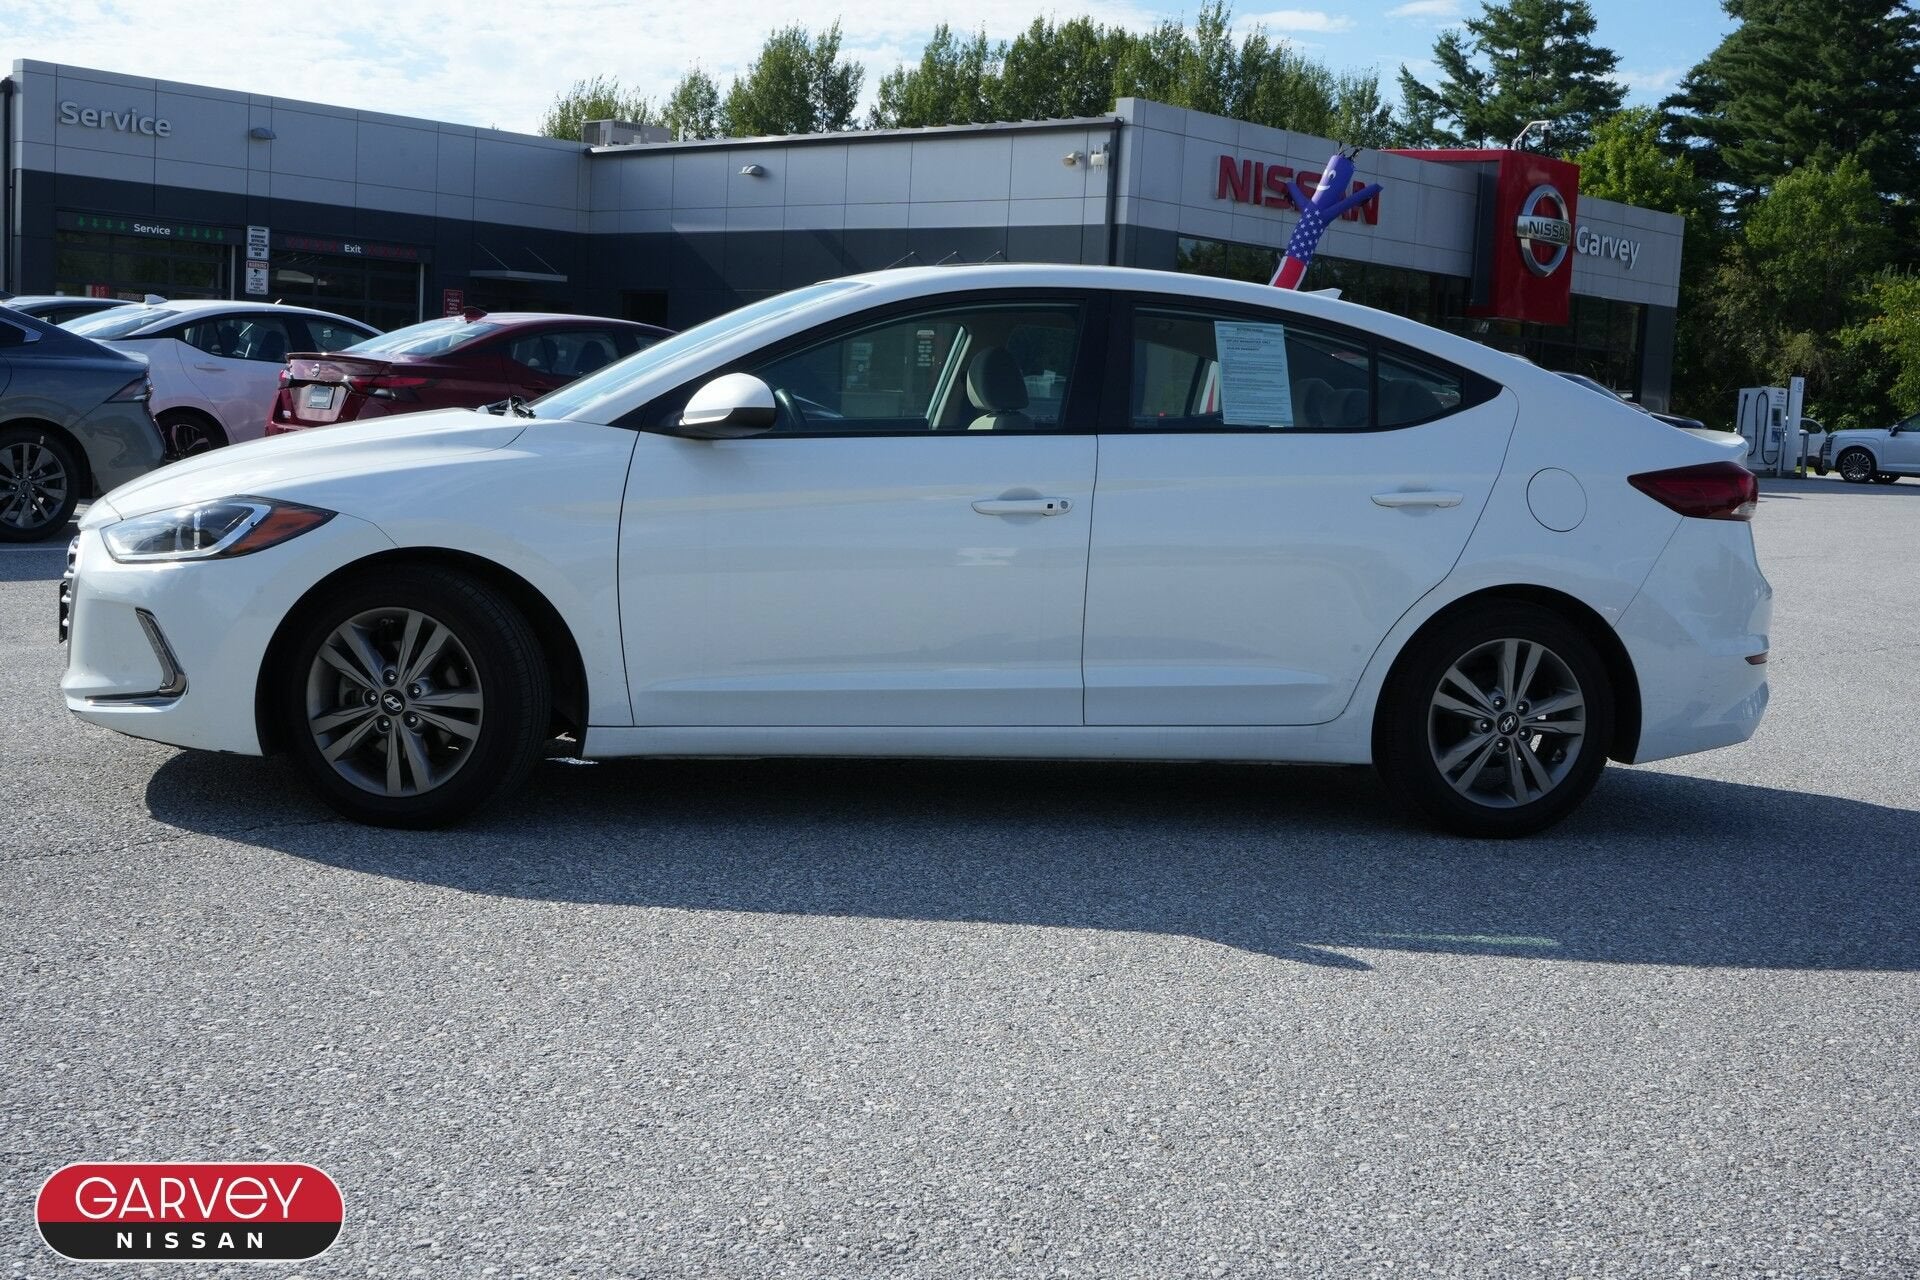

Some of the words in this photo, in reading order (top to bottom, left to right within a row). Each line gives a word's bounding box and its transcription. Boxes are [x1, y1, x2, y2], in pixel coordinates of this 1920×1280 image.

[61, 101, 172, 137] Service
[1217, 155, 1380, 225] NISSN
[133, 223, 171, 235] Service
[344, 244, 362, 254] Exit
[1576, 226, 1640, 270] Garvey
